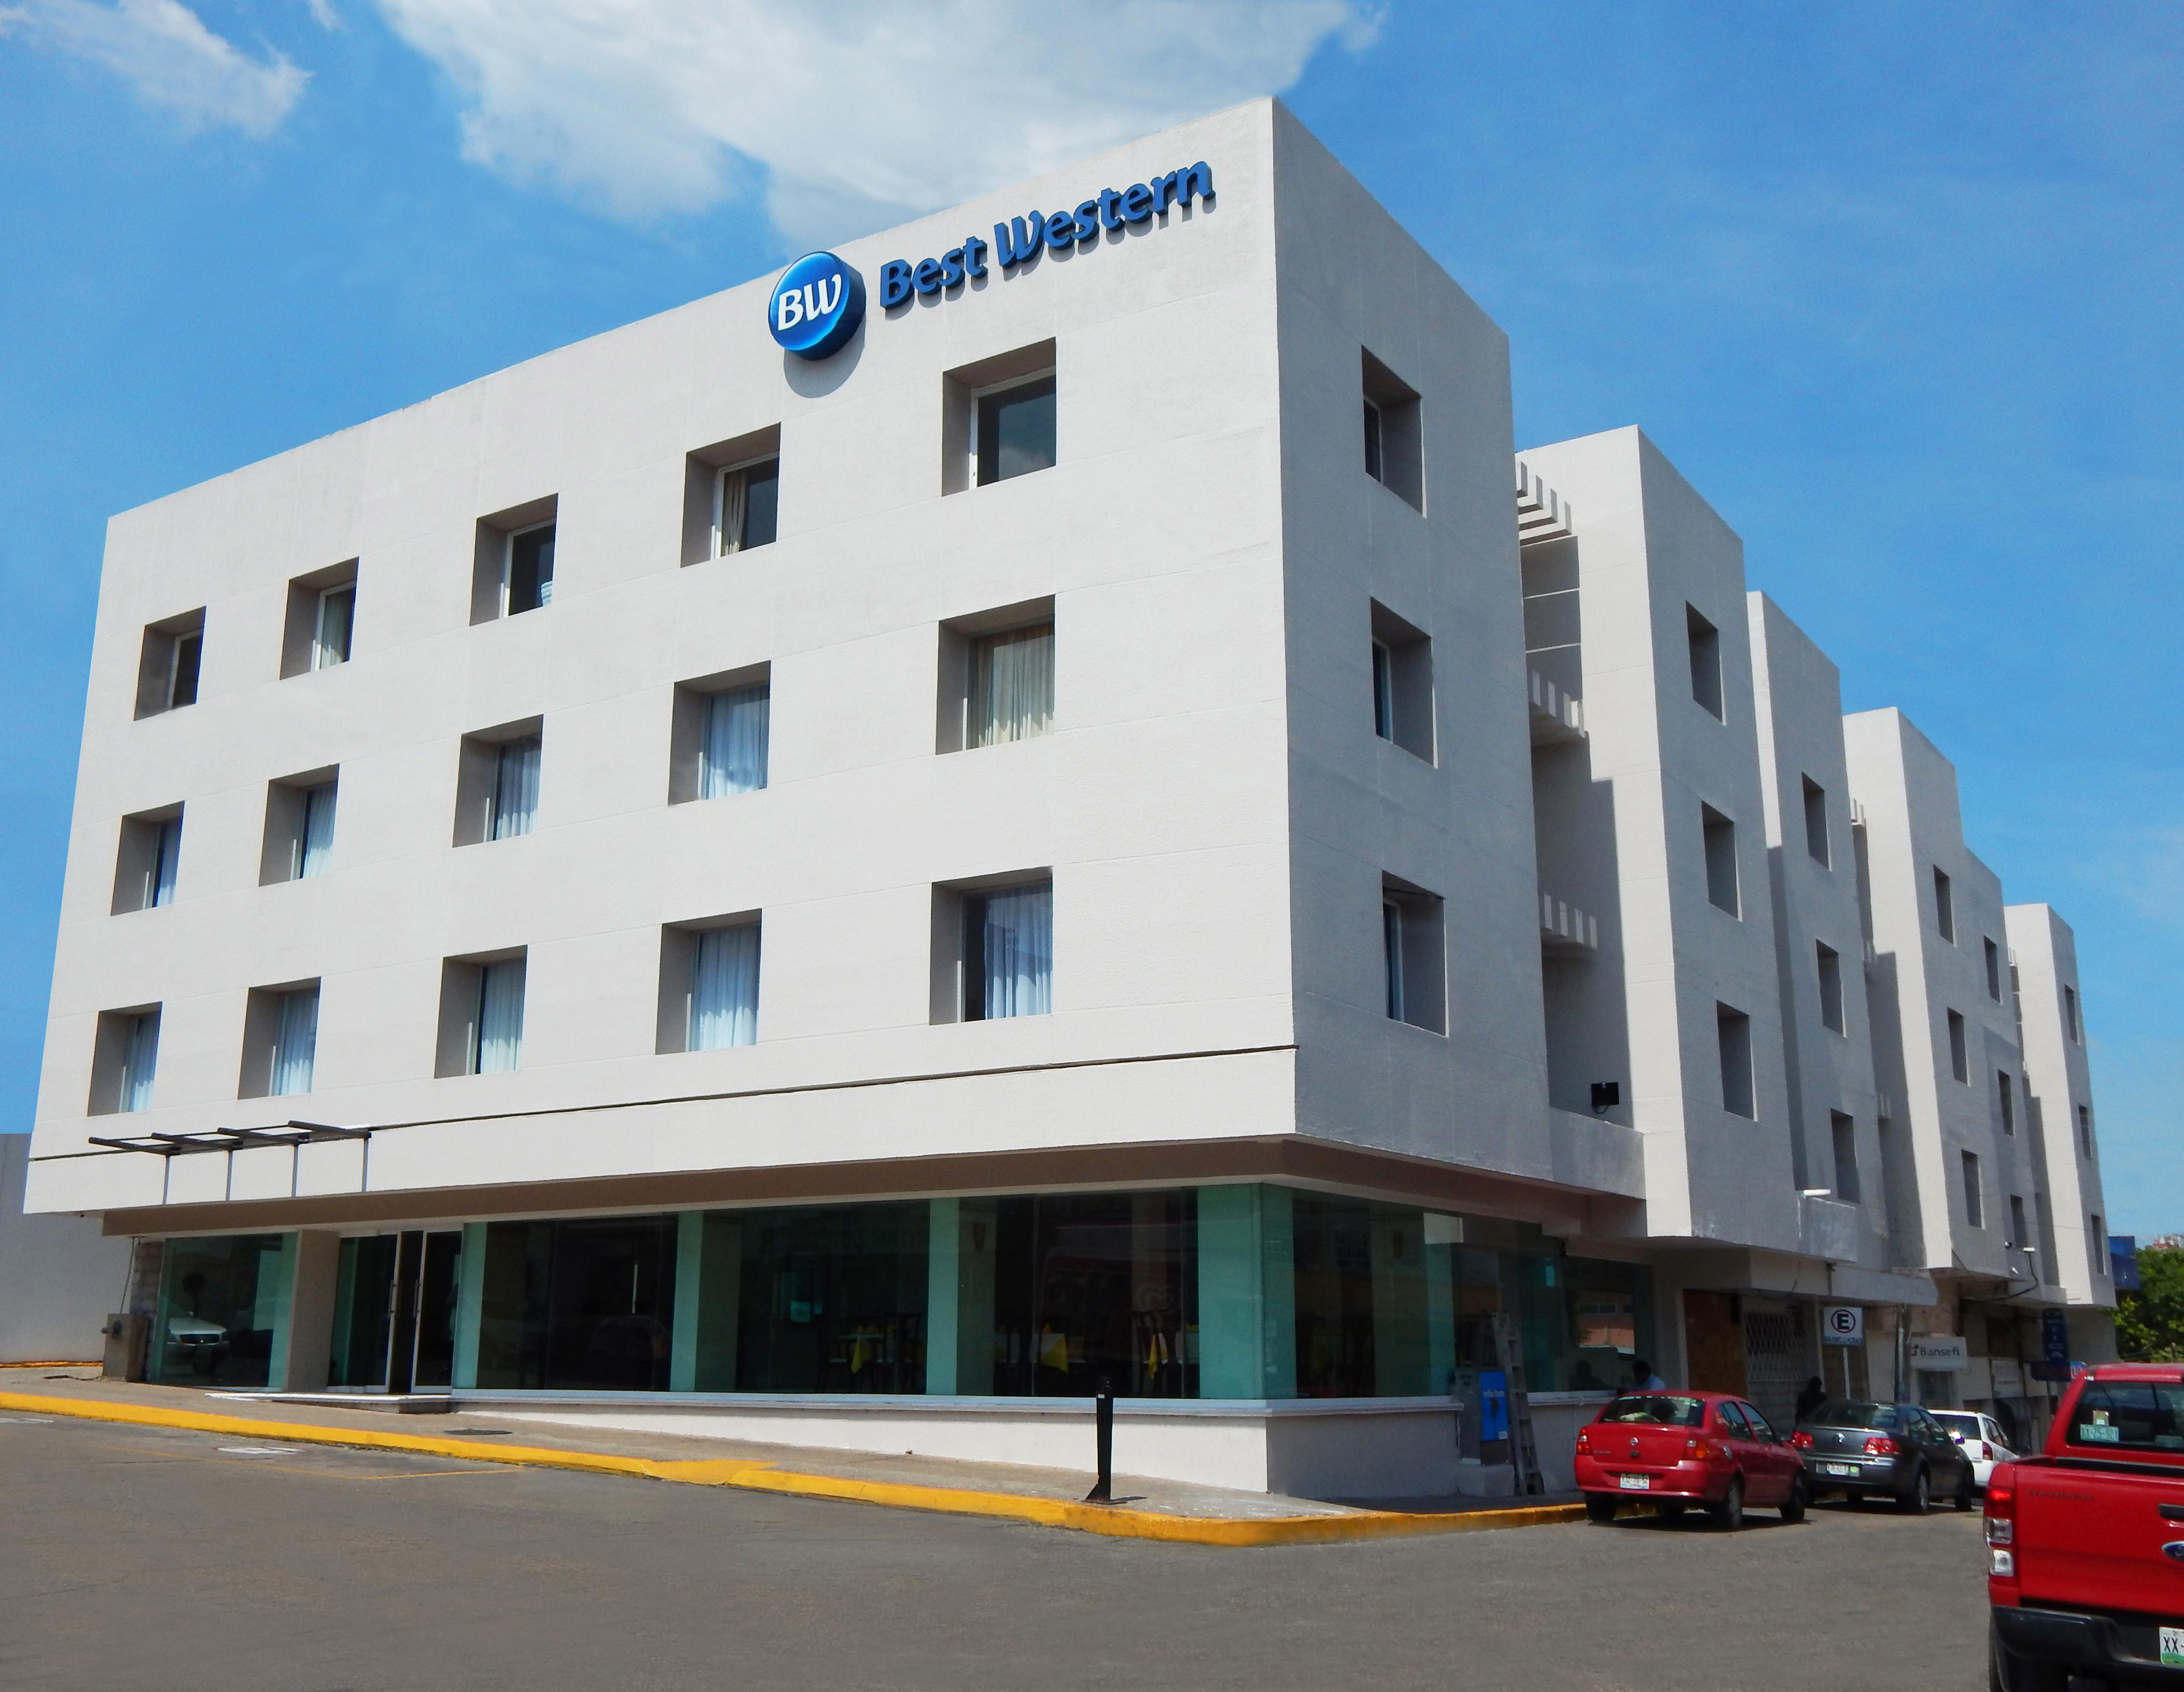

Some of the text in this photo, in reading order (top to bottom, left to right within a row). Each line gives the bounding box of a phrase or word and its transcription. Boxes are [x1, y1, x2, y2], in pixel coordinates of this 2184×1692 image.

[880, 161, 1216, 309] Best Western
[778, 274, 842, 331] BW
[1837, 1313, 1850, 1330] E
